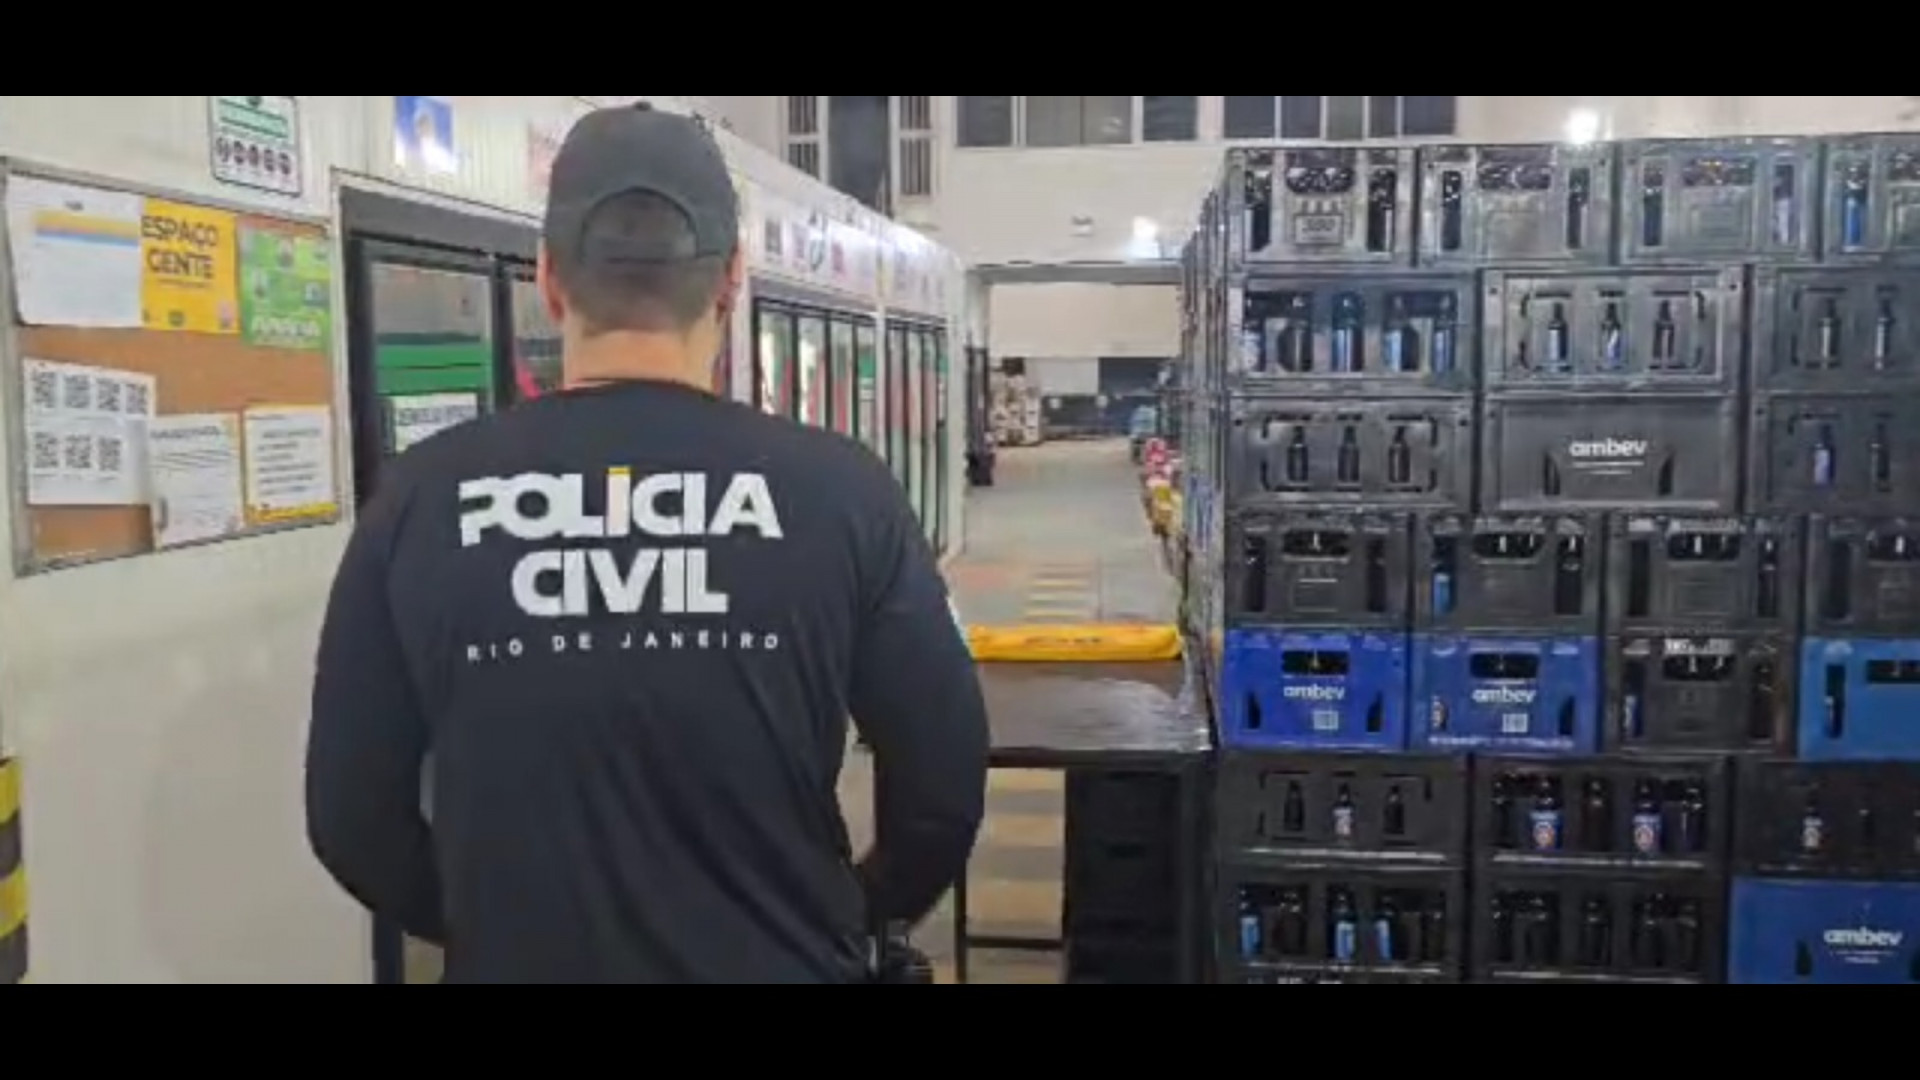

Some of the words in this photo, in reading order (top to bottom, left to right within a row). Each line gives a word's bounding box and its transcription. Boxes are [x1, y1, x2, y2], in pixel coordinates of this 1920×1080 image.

[1568, 437, 1648, 458] ambev
[511, 548, 730, 617] CIVIL
[466, 638, 524, 662] RIO
[552, 634, 593, 652] DE
[620, 630, 779, 650] JANEIRO
[1283, 683, 1345, 700] ambev
[1471, 686, 1536, 703] ambev
[1823, 926, 1904, 947] ambev
